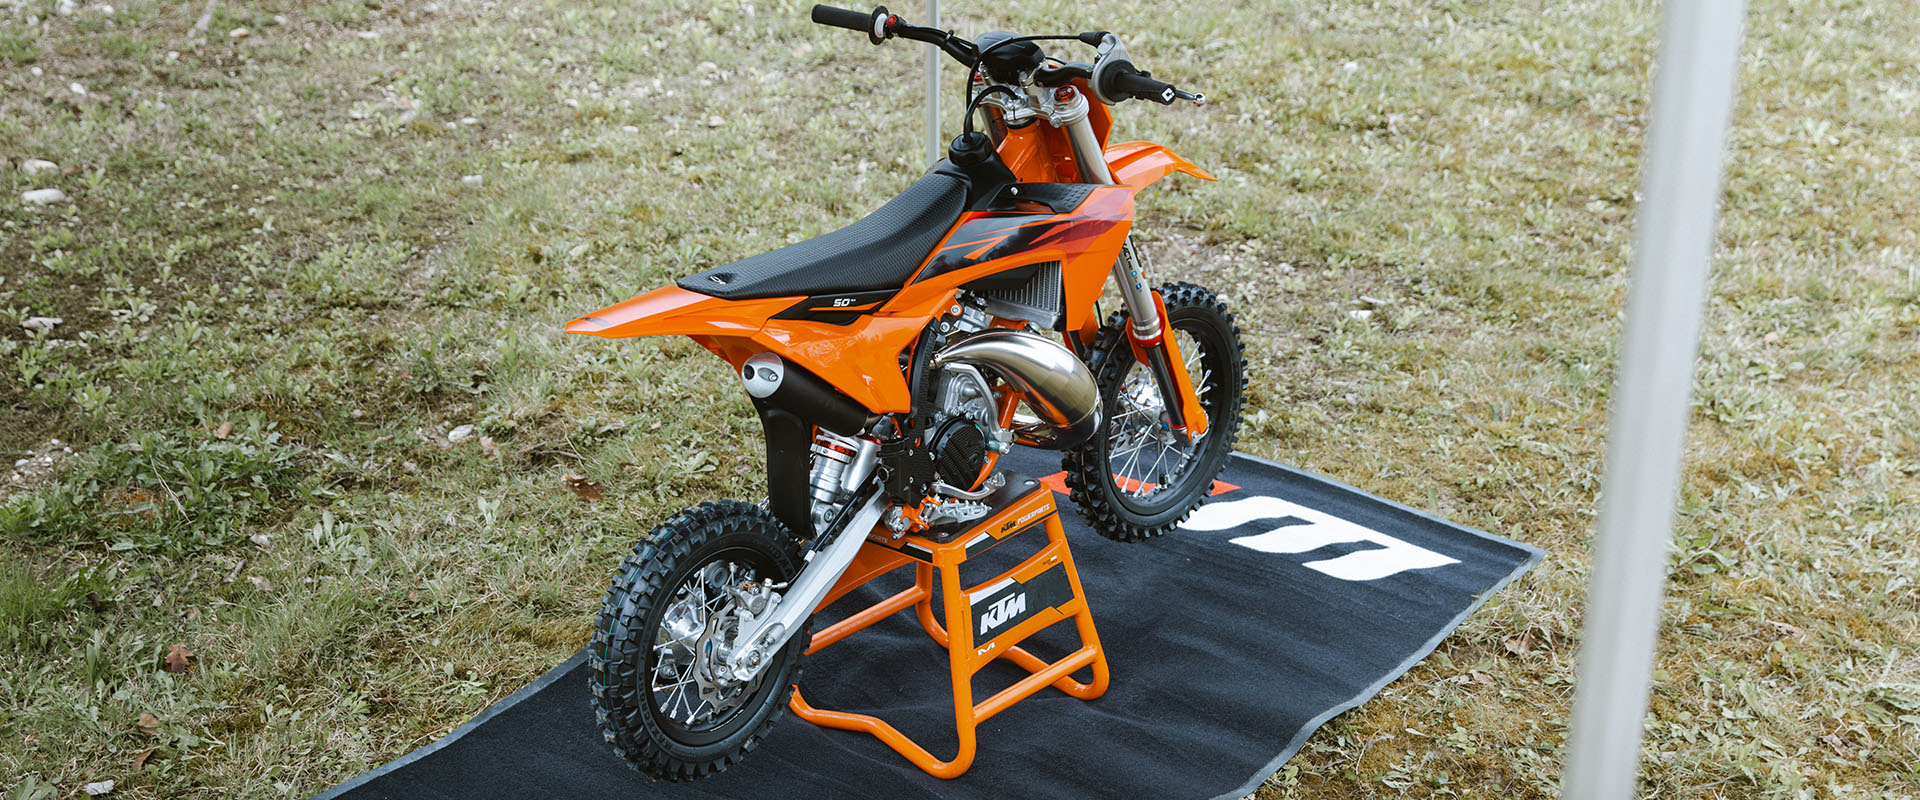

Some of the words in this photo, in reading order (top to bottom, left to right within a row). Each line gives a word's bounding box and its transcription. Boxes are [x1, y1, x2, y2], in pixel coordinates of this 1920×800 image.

[832, 298, 850, 307] 50
[1000, 520, 1016, 533] KTM
[980, 591, 1026, 636] KTM
